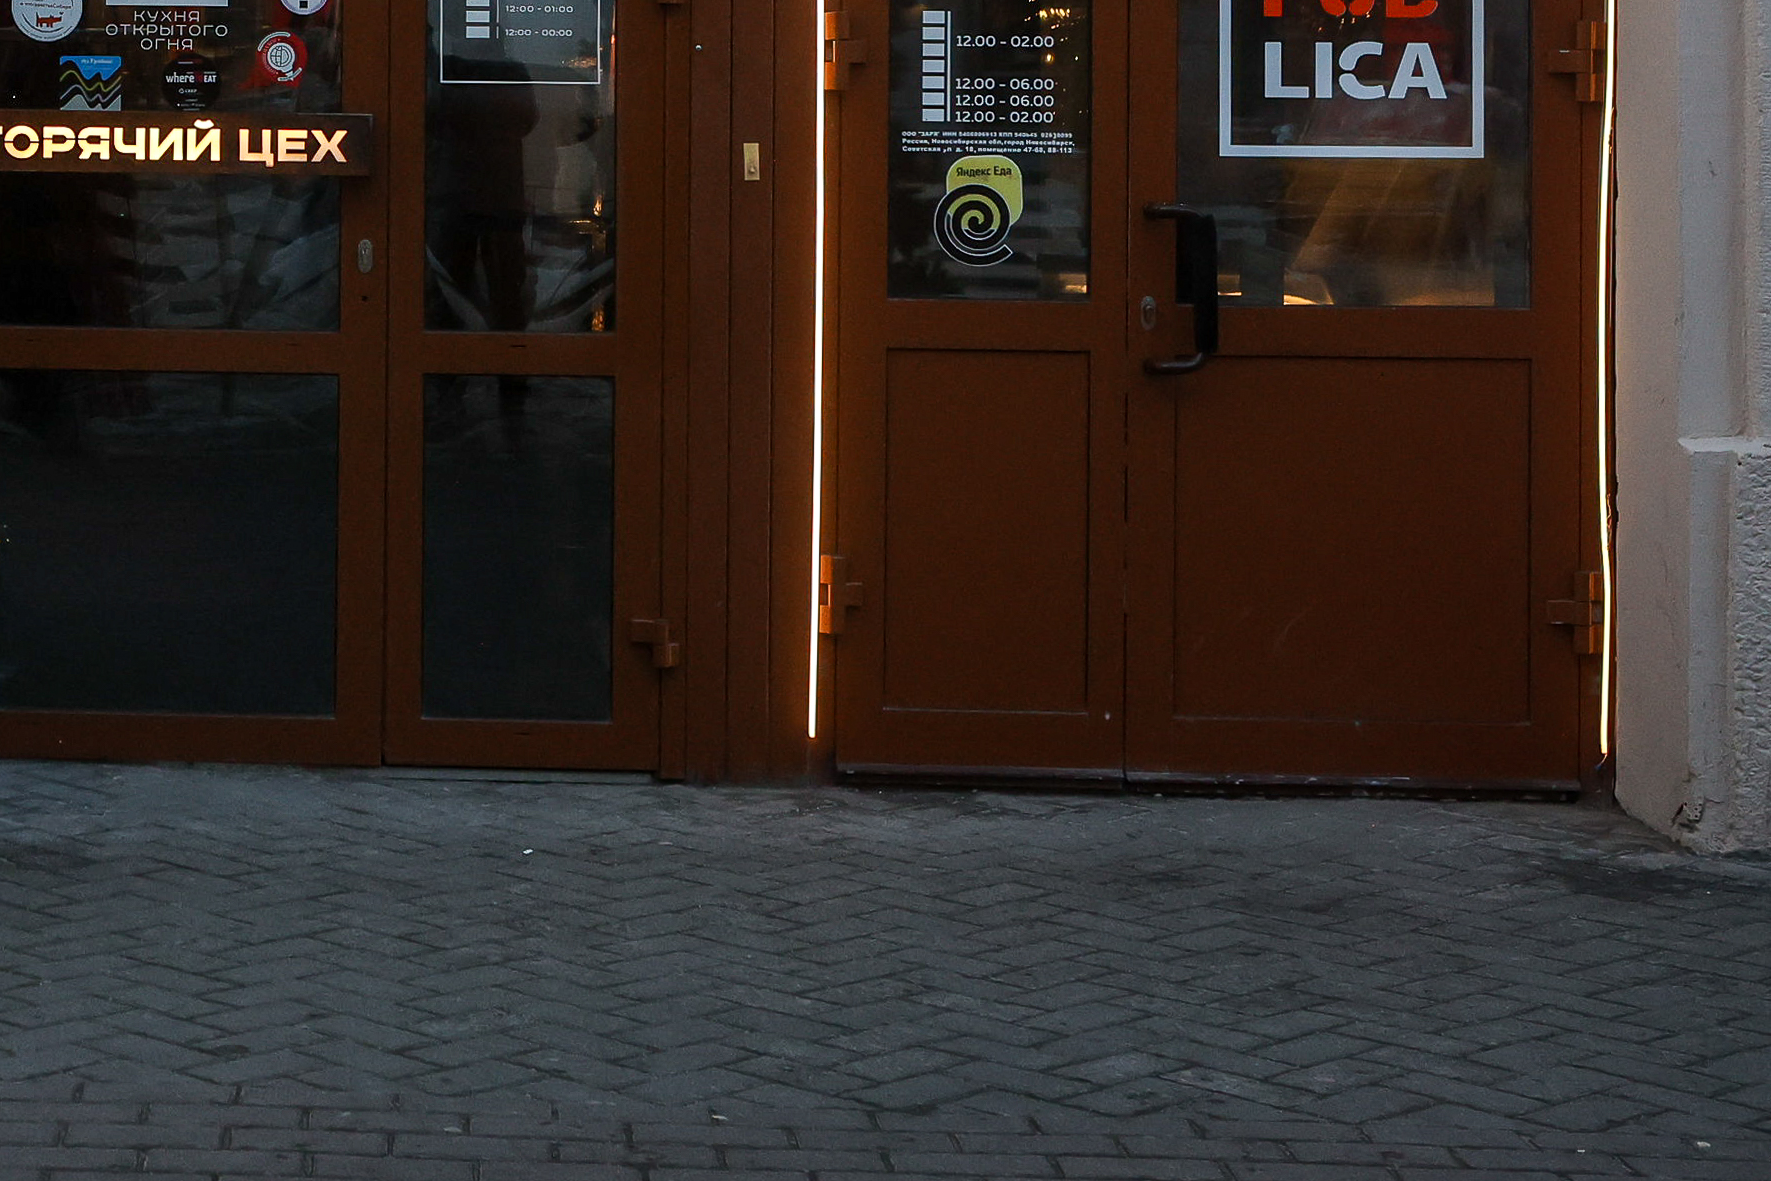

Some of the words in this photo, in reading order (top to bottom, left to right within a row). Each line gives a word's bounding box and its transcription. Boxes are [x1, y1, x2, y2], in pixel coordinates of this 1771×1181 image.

[506, 5, 534, 13] 12:00
[544, 5, 574, 13] 01:00
[133, 10, 200, 22] КУХНЯ
[105, 23, 228, 38] ОТКРЫТОГО
[541, 29, 573, 37] 00:00
[140, 38, 193, 51] ОГНЯ
[956, 35, 996, 48] 12.00
[1010, 35, 1055, 48] 02.00
[1264, 40, 1448, 100] LICA
[165, 71, 195, 83] where
[203, 75, 217, 83] EAT
[955, 78, 995, 90] 12.00
[1009, 78, 1055, 90] 06.00
[955, 95, 995, 107] 12.00
[1009, 95, 1055, 107] 06.00
[955, 112, 995, 123] 12.00
[1009, 112, 1054, 124] 02.00
[238, 128, 348, 167] ЦЕХ
[956, 167, 991, 177] Яндекс
[993, 166, 1012, 176] Еда
